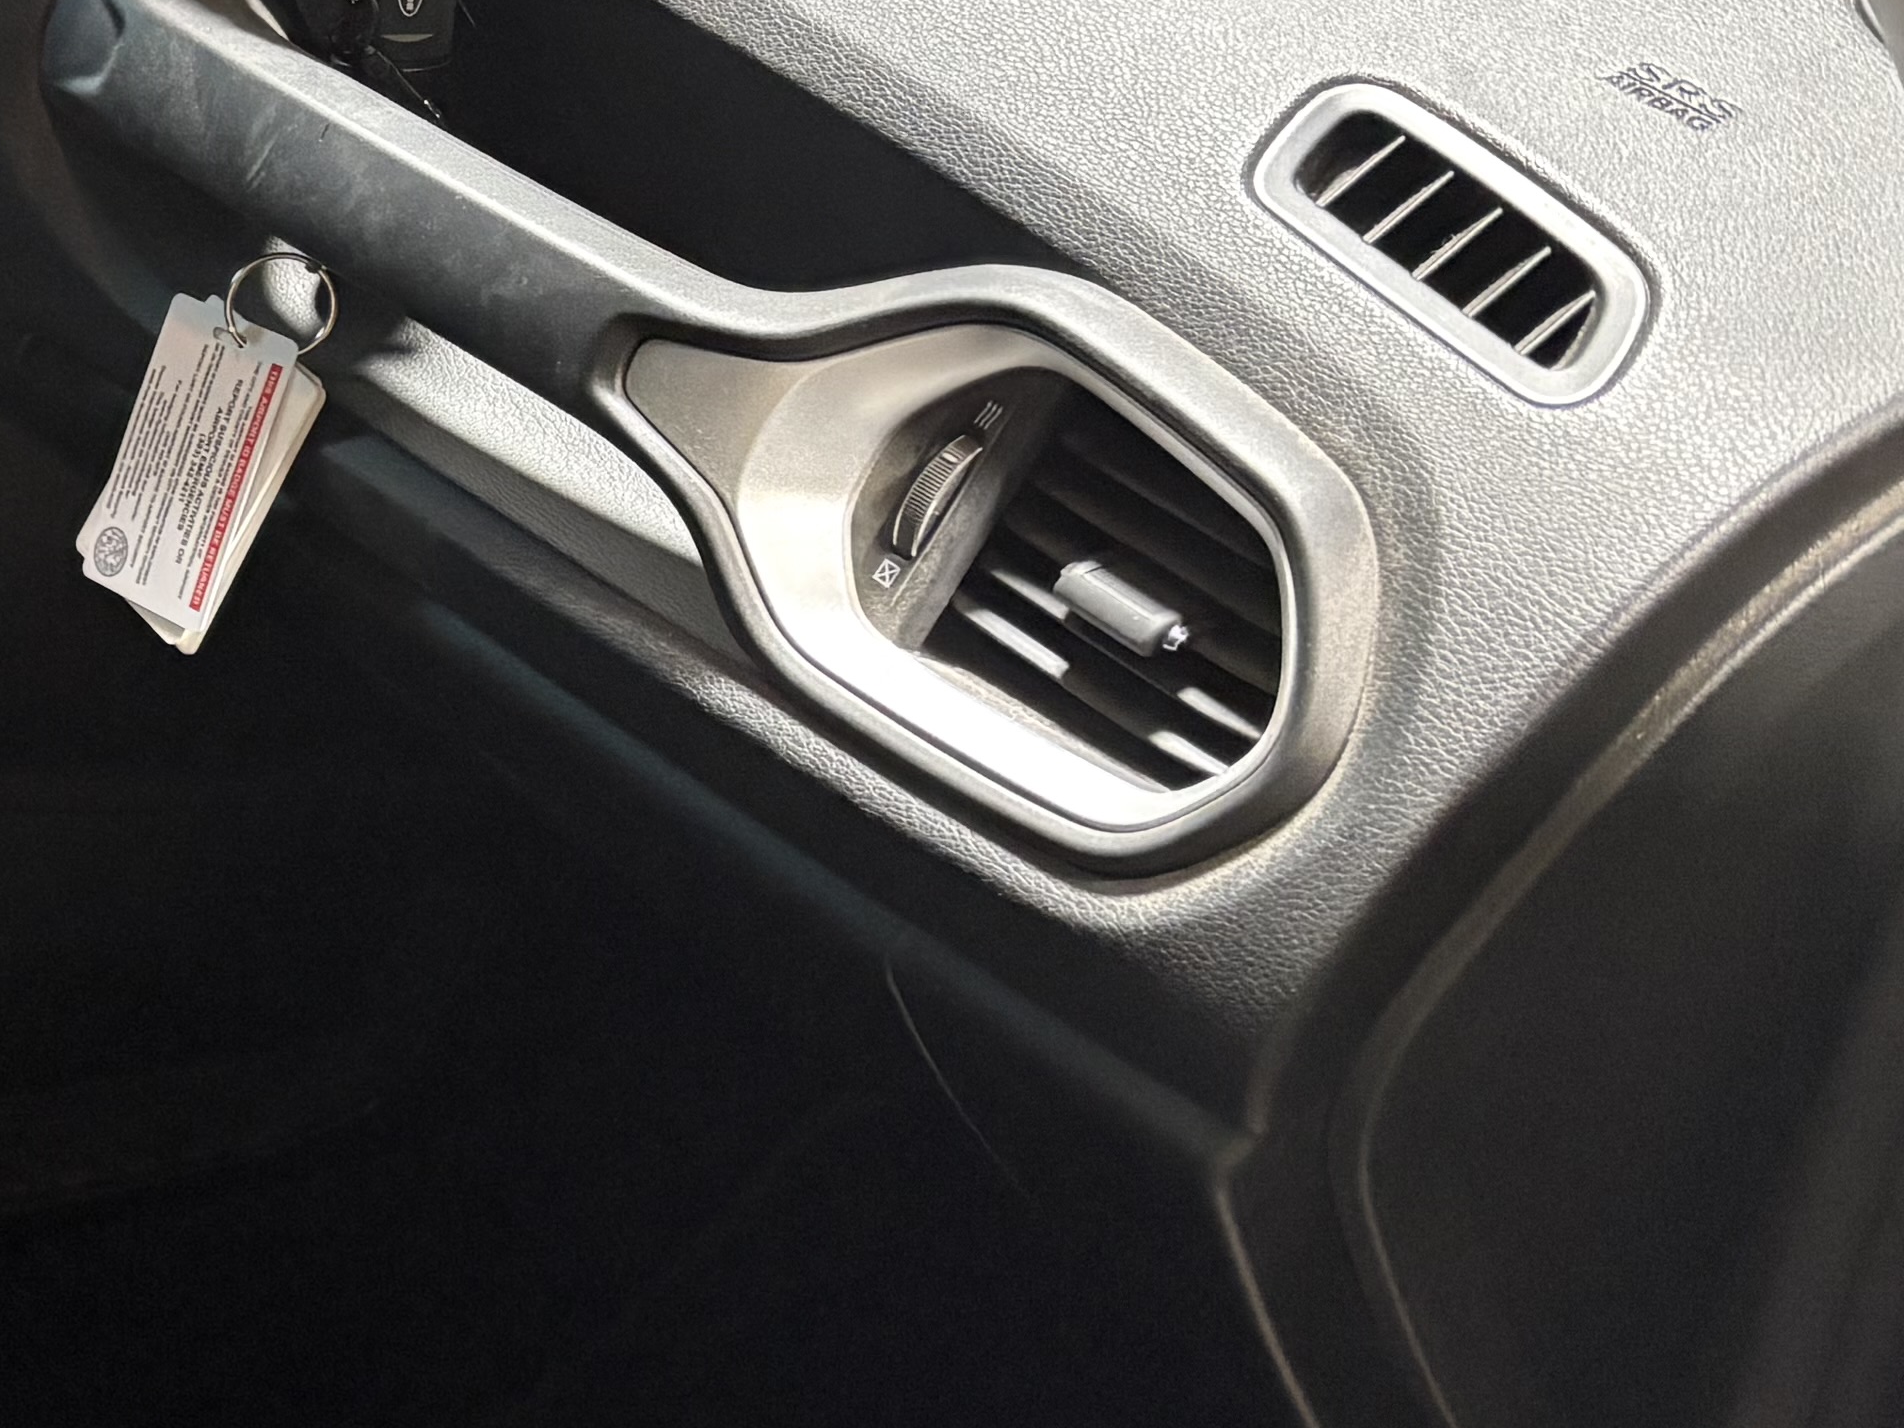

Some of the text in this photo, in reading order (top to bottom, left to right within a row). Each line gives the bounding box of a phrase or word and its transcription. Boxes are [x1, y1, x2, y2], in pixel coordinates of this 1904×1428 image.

[1597, 72, 1714, 132] AIRBAG
[1626, 62, 1743, 119] SRS
[174, 378, 244, 564] REPORT SUSPICIOUS ACTIVITIES OR
[175, 406, 224, 531] AIRPORT EMERGENCIES
[190, 370, 277, 605] THIS AIRPORT ID BADGE MUST BE RETURNED
